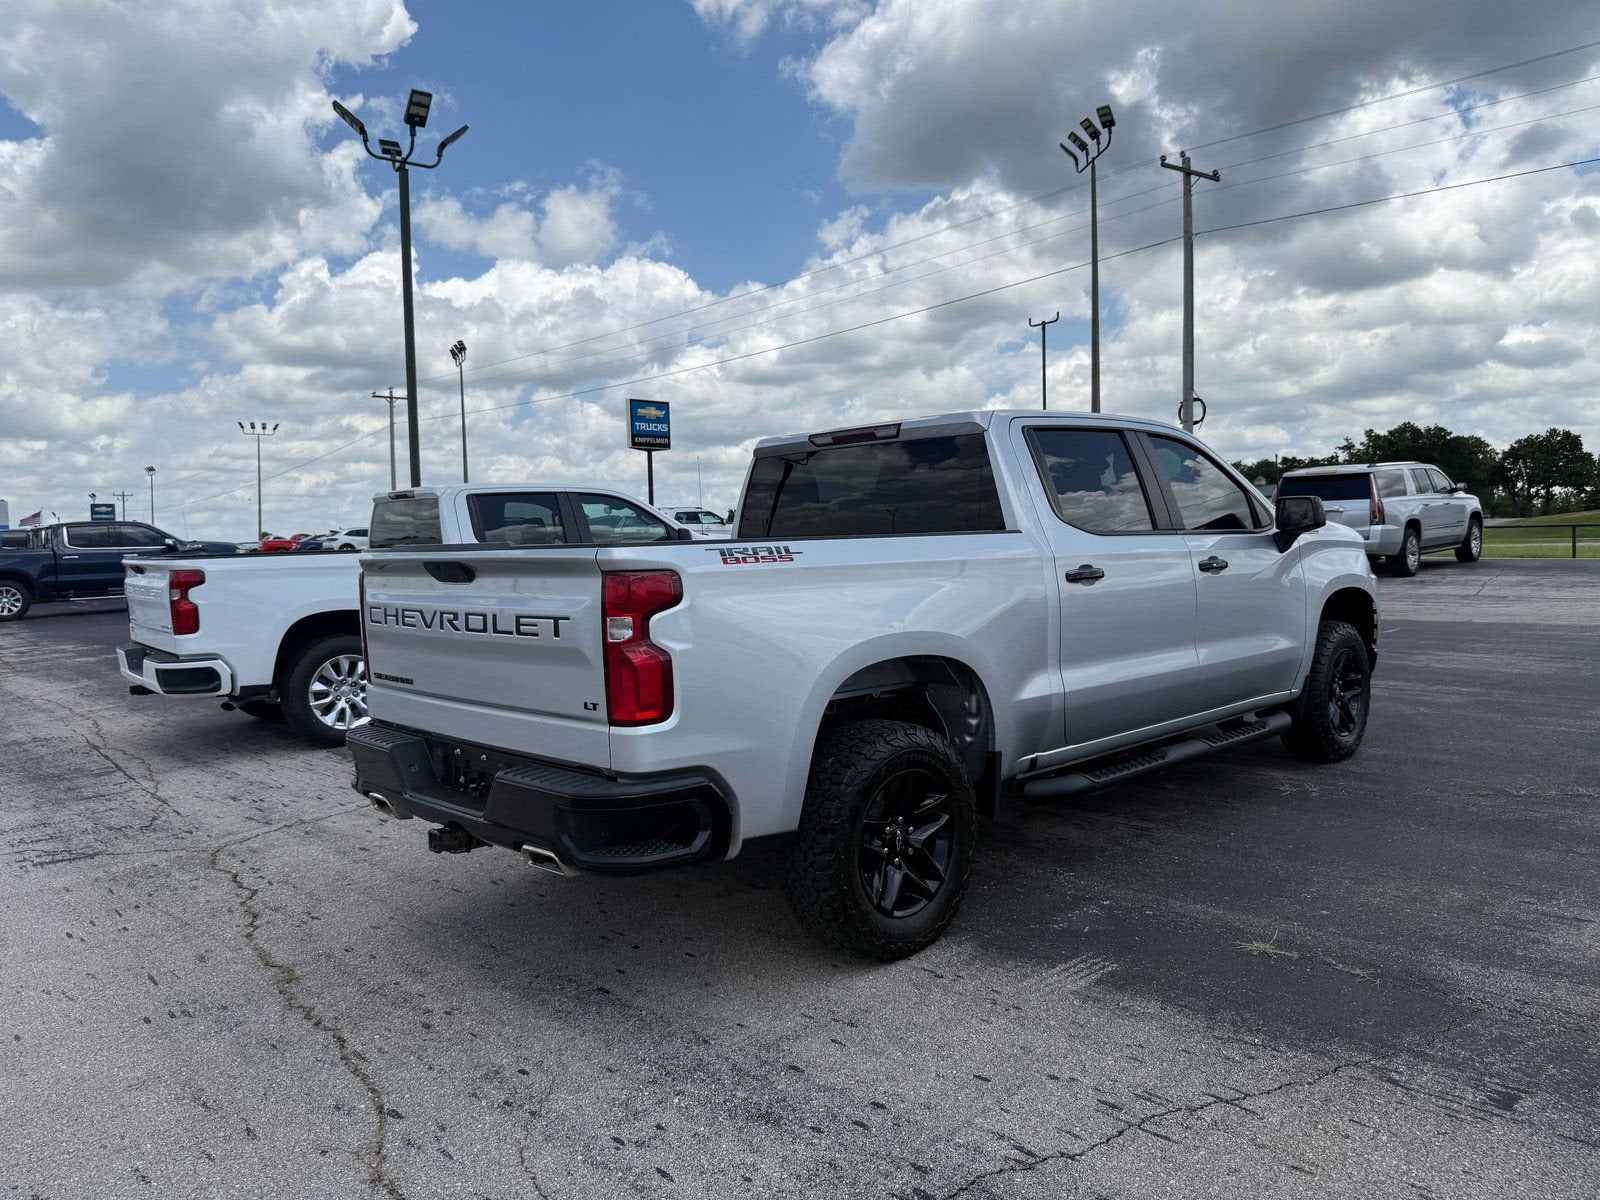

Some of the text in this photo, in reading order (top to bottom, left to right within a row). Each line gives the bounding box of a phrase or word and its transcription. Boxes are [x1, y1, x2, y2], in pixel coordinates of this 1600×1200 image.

[635, 422, 668, 432] TRUCKS
[704, 545, 803, 557] TRAIL
[721, 554, 794, 565] BOSS
[369, 606, 571, 639] CHEVROLET
[583, 701, 599, 711] LT
